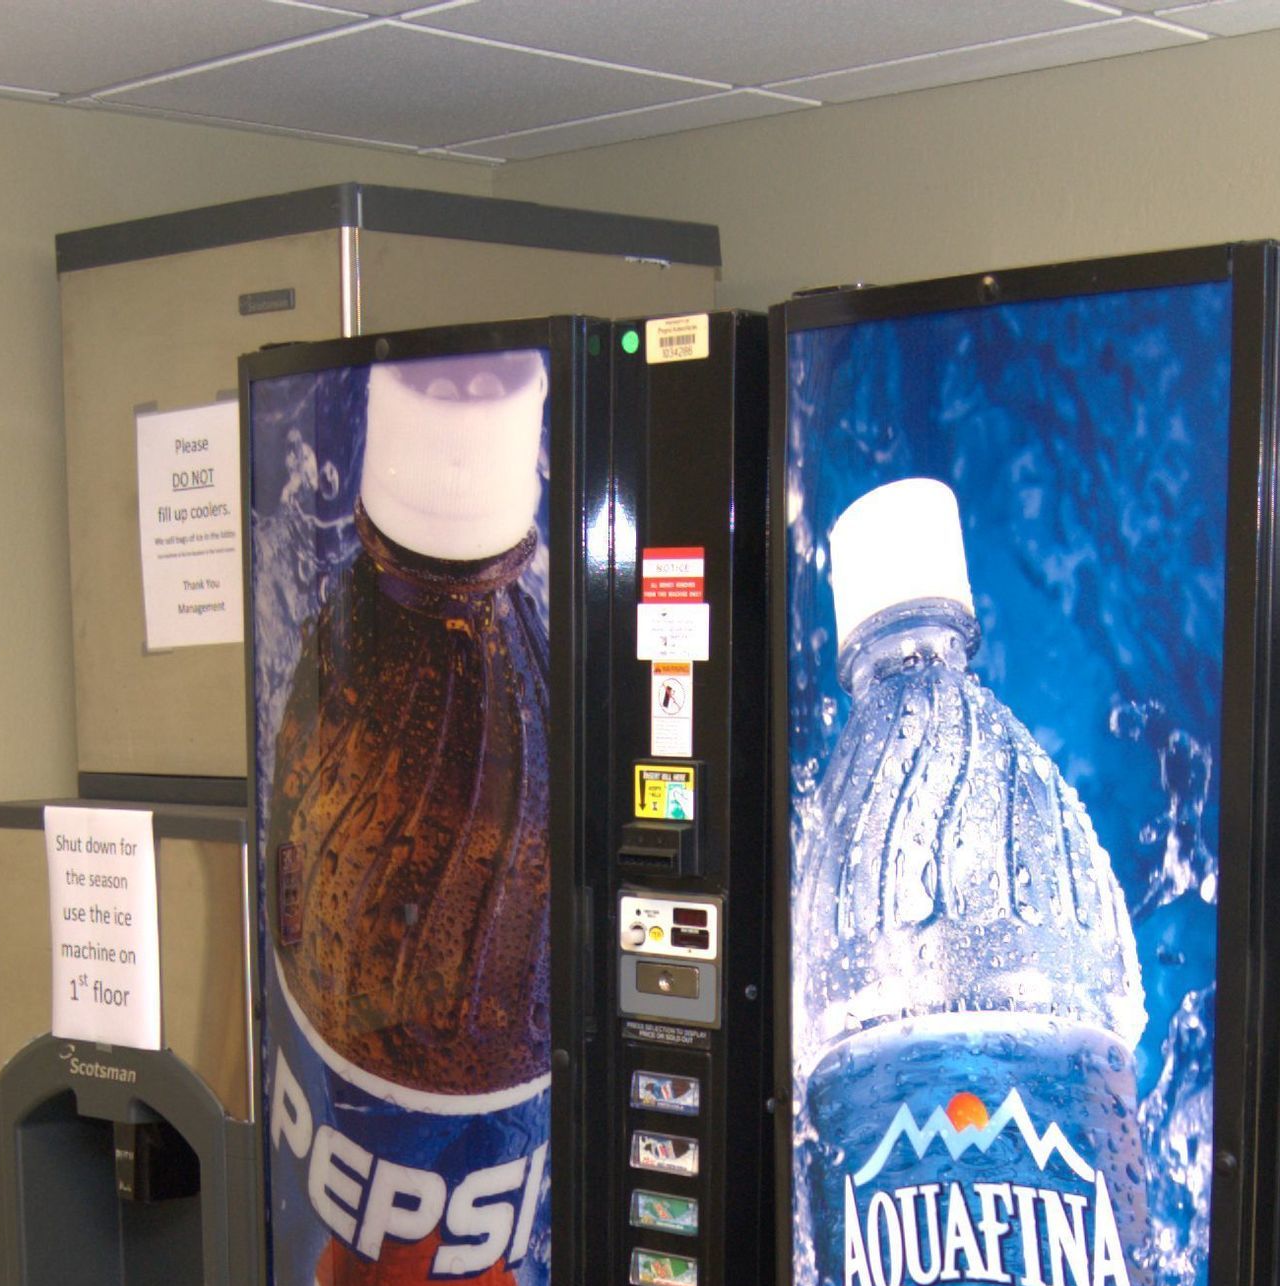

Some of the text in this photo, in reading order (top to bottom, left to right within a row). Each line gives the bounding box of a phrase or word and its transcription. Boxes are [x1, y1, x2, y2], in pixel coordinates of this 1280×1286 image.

[175, 437, 208, 454] Please
[172, 468, 214, 488] DO NOT
[158, 502, 231, 524] fill up coolers.
[183, 579, 220, 591] Thank You
[178, 600, 225, 615] Management
[56, 835, 137, 856] Shut down for
[66, 869, 128, 889] the season
[63, 904, 132, 926] use the ice
[61, 941, 136, 964] machine on
[93, 980, 130, 1006] floor
[70, 1057, 136, 1083] Scotsman
[270, 1046, 550, 1276] PEPSI
